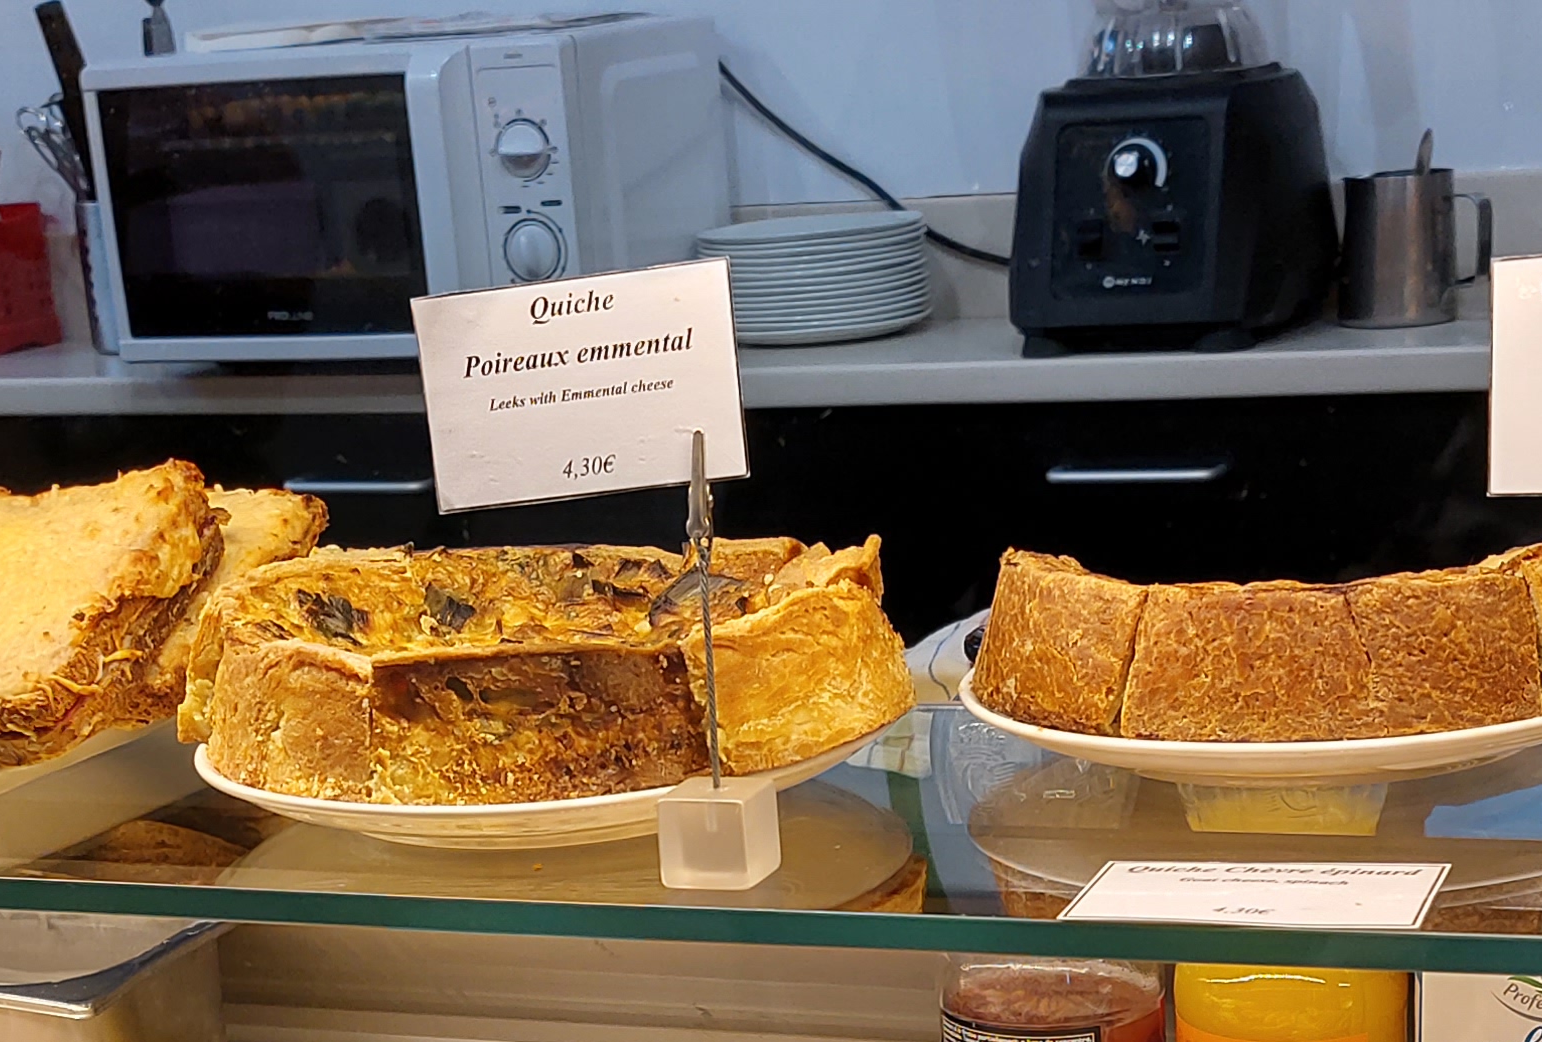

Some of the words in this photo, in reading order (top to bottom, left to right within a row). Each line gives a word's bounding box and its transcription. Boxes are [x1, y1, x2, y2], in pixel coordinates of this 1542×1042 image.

[530, 290, 614, 325] Quiche
[462, 348, 569, 379] Poireaux
[577, 327, 693, 363] emmental
[490, 393, 526, 412] Leeks
[530, 391, 557, 405] with
[561, 381, 628, 402] Emmental
[631, 379, 674, 394] cheese
[562, 454, 616, 480] 4,30€
[1127, 865, 1216, 874] Quiche
[1224, 865, 1315, 875] Chèvre
[1319, 866, 1423, 878] épinard
[1283, 878, 1349, 886] spinach
[1212, 906, 1275, 916] 4,30€
